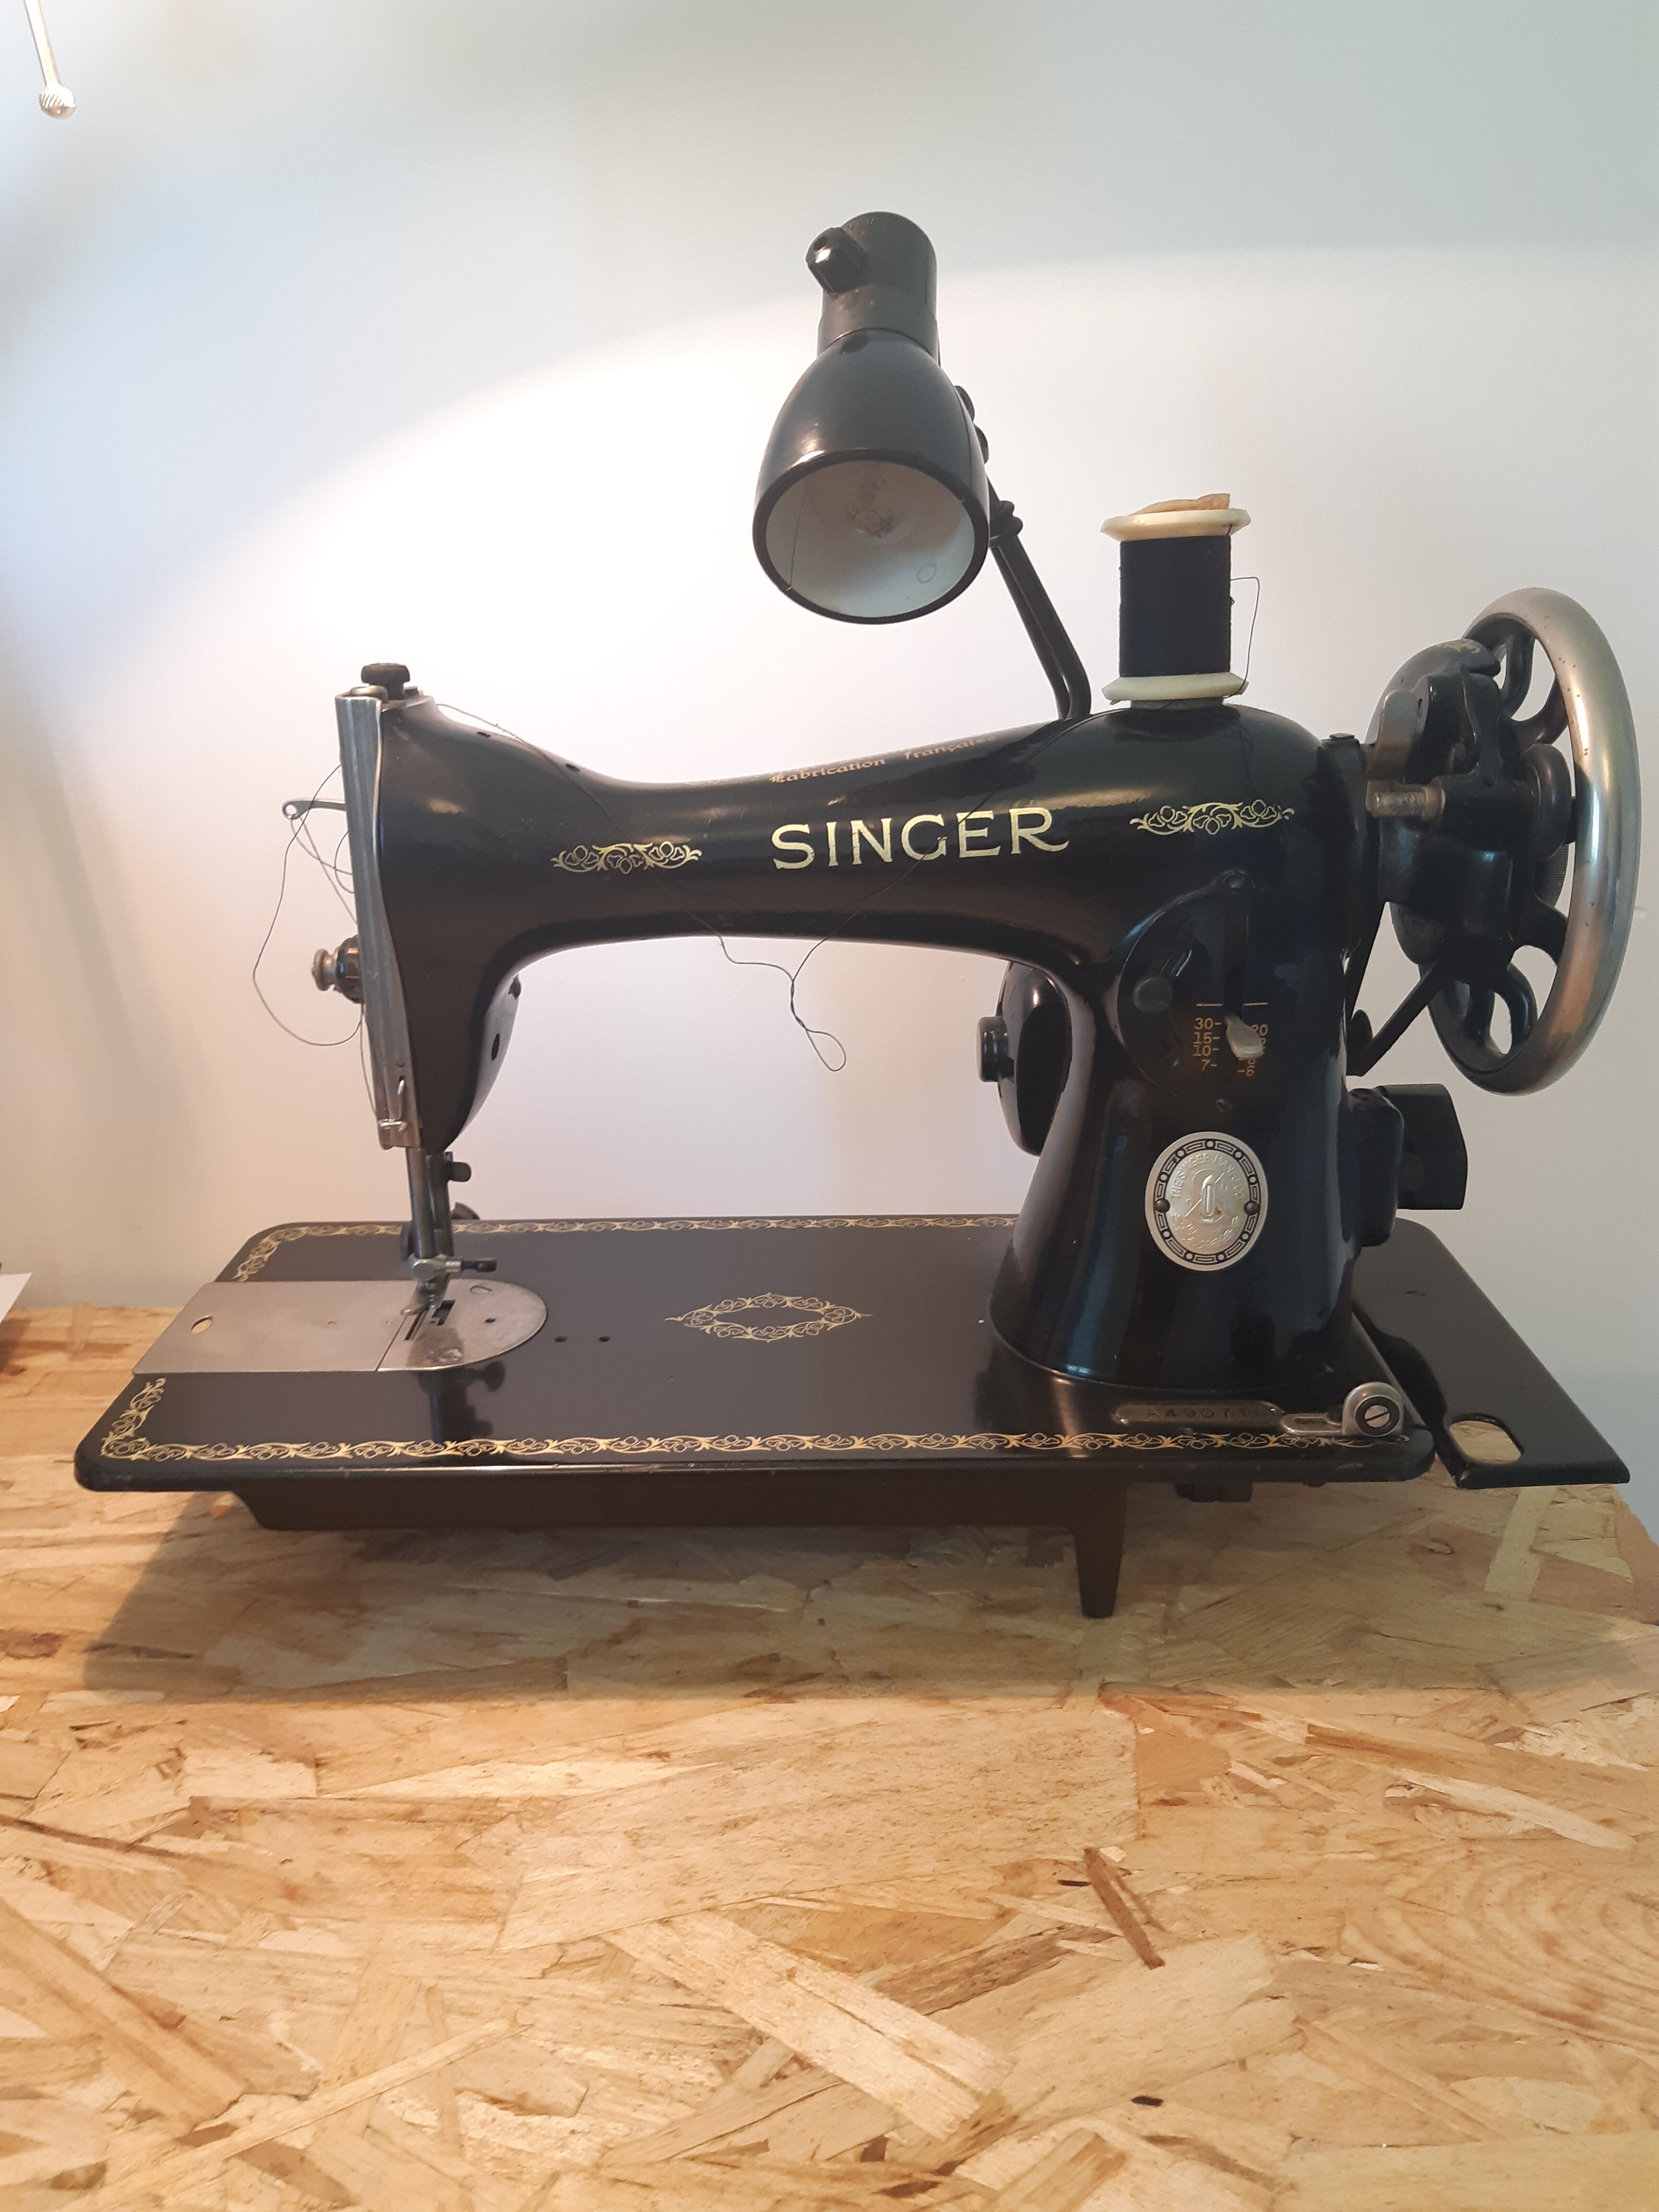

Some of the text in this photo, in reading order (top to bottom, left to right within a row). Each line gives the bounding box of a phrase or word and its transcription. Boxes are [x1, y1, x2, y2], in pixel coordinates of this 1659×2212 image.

[771, 807, 1069, 870] SINGER
[1194, 1017, 1214, 1030] 30
[1193, 1032, 1212, 1045] 15
[1192, 1045, 1211, 1057] 10
